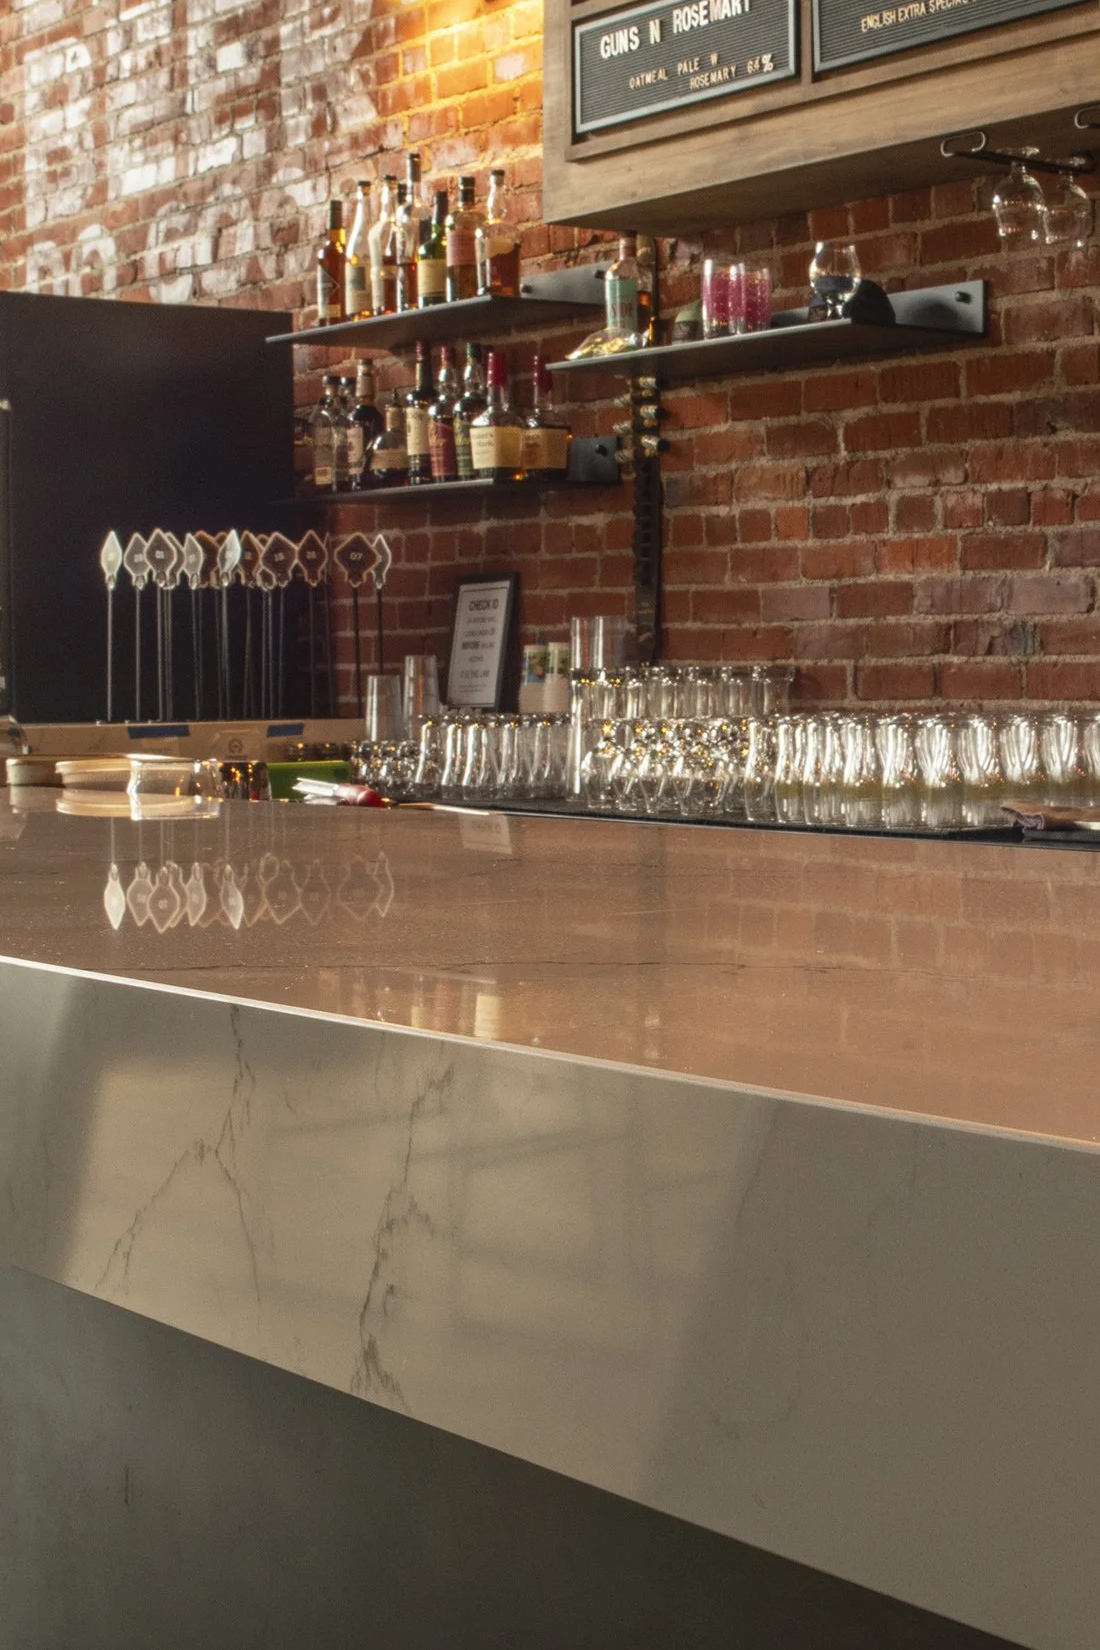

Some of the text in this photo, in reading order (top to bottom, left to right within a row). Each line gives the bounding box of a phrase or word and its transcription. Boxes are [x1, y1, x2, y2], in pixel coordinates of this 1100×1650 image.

[861, 10, 897, 33] ENGLISH
[897, 1, 927, 24] EXTRA
[599, 25, 641, 59] GUNS
[649, 18, 662, 45] N
[629, 66, 669, 91] OATMEAL
[676, 58, 701, 77] PALE
[689, 64, 737, 91] ROSEMARY
